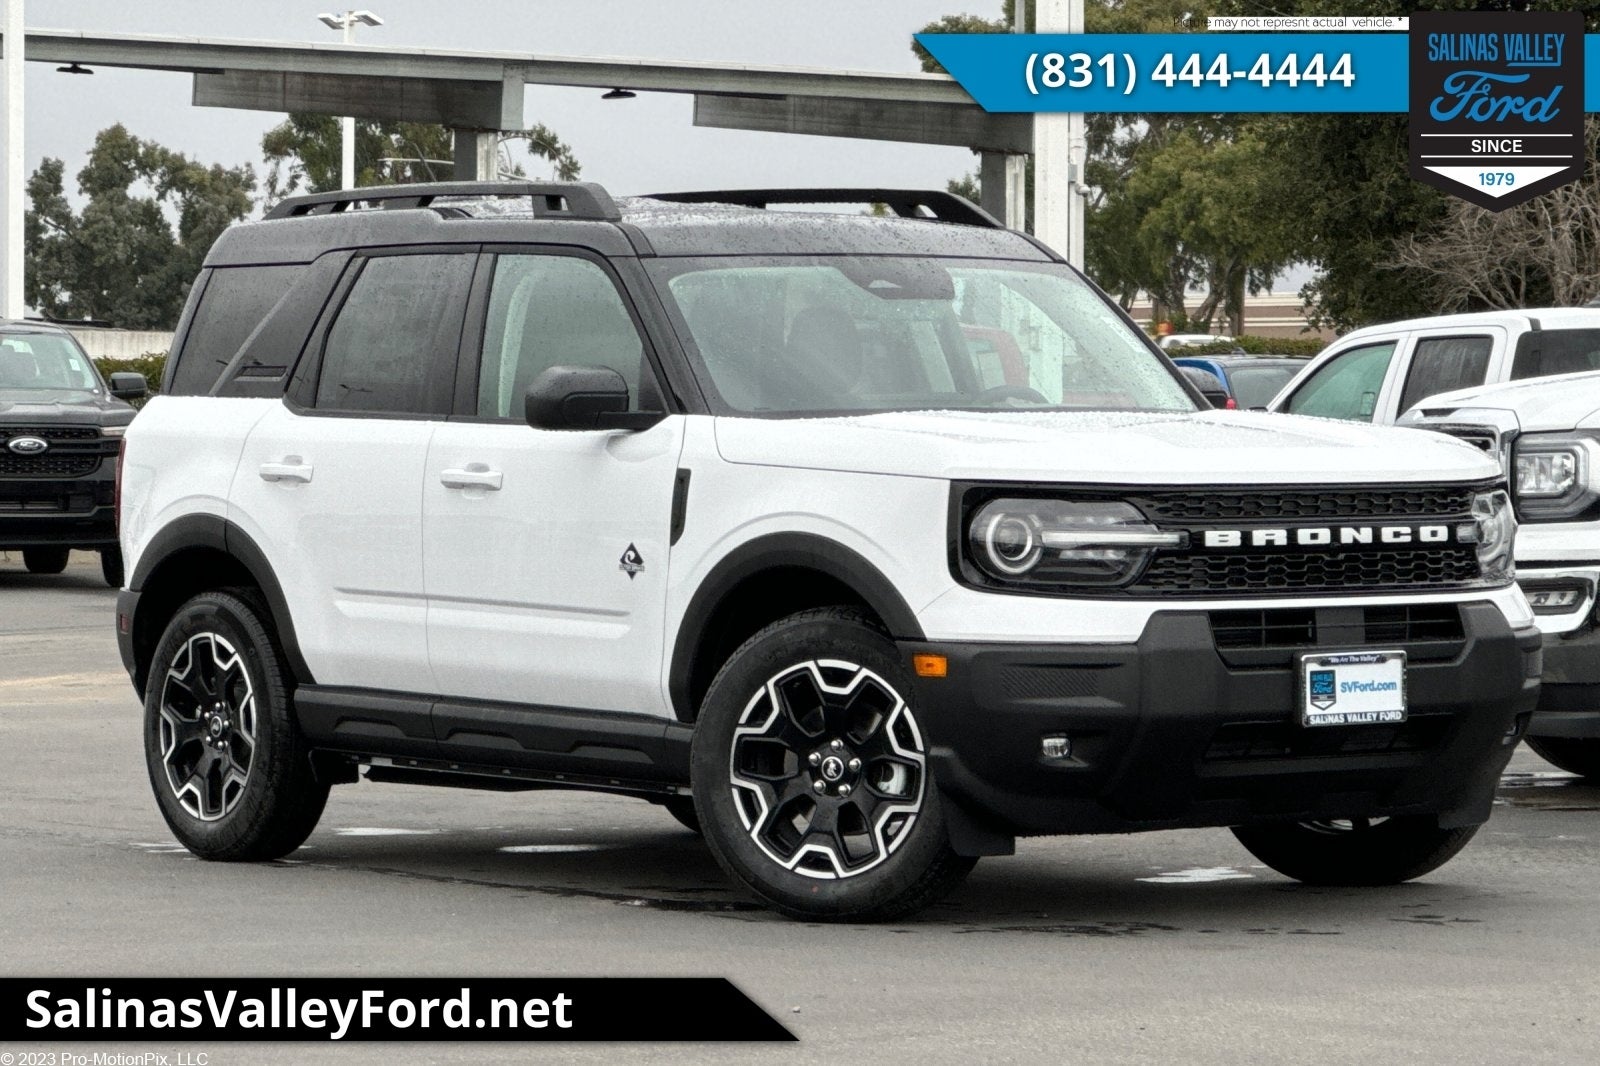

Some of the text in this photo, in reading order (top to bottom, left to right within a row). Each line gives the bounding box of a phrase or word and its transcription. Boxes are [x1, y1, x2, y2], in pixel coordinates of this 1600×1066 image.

[1204, 525, 1449, 547] BRONCO
[1340, 680, 1397, 693] SVFord.com
[1309, 710, 1402, 724] SALINAS VALLEY FORD
